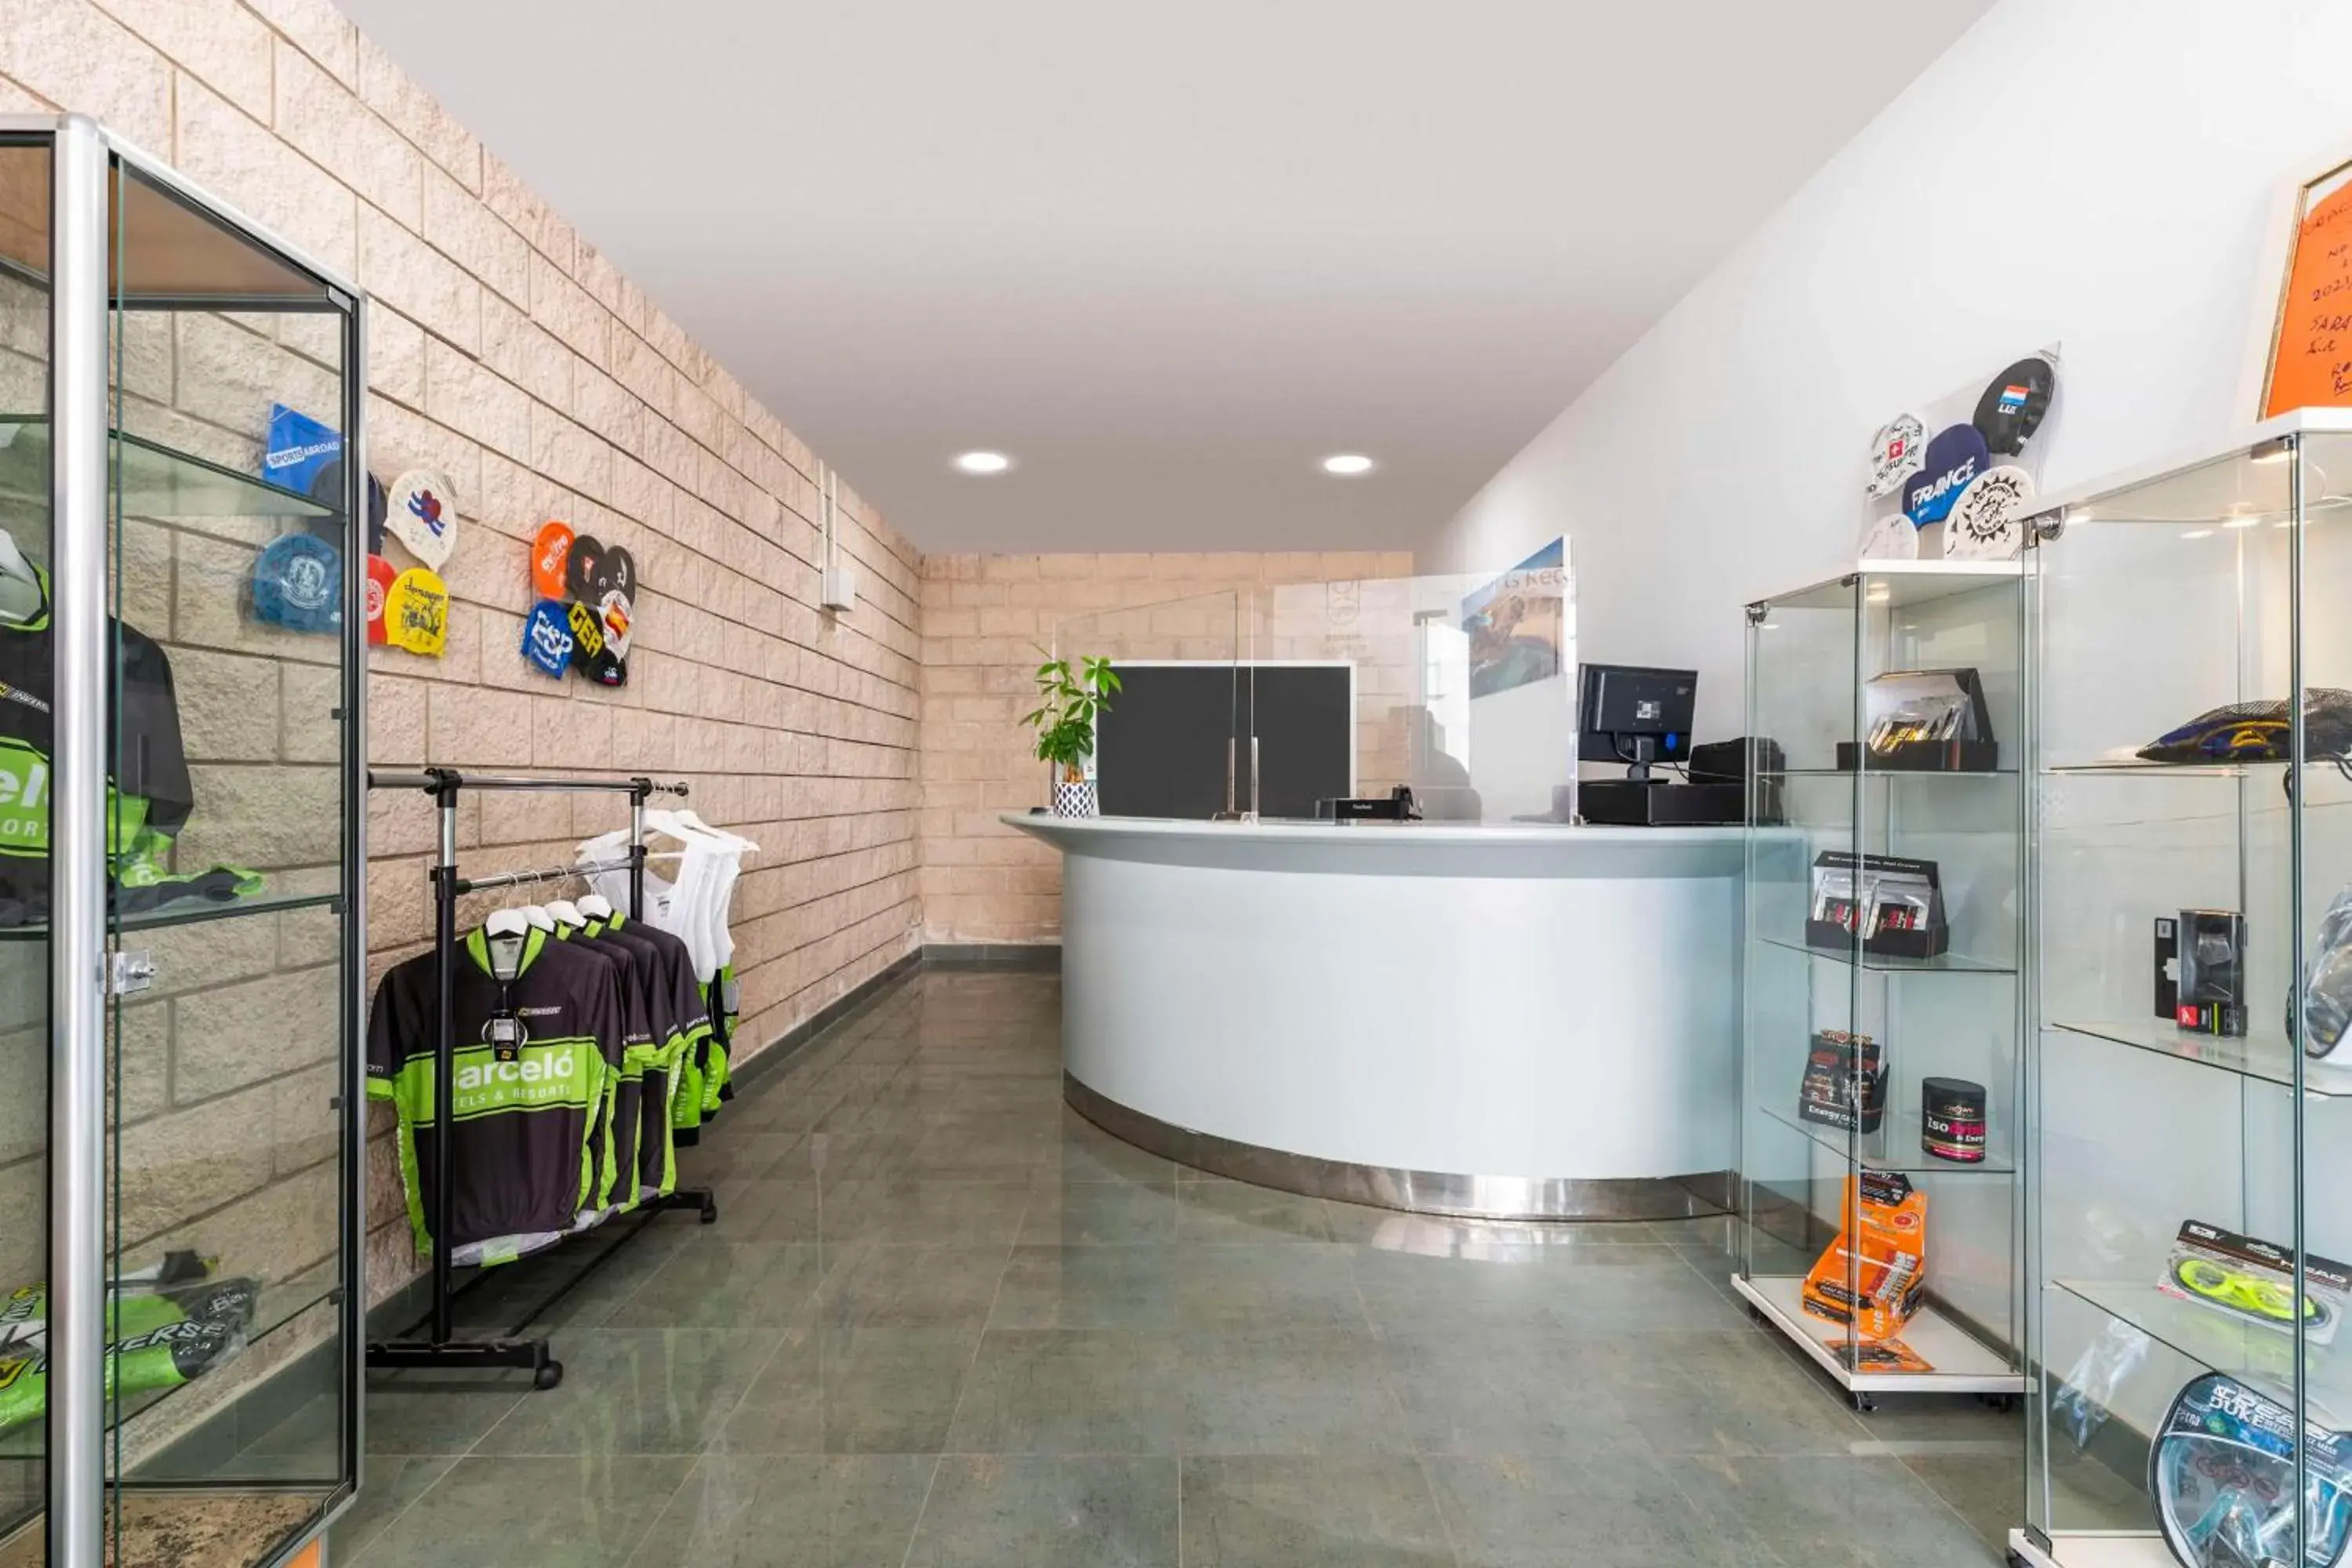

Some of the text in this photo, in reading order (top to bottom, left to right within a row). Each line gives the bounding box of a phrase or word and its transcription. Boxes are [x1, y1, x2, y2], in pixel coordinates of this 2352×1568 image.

[1912, 456, 1975, 512] FRANCE
[567, 601, 603, 659] GER
[453, 1049, 574, 1089] arceló
[494, 1090, 504, 1101] &
[1808, 1105, 1840, 1122] Energy
